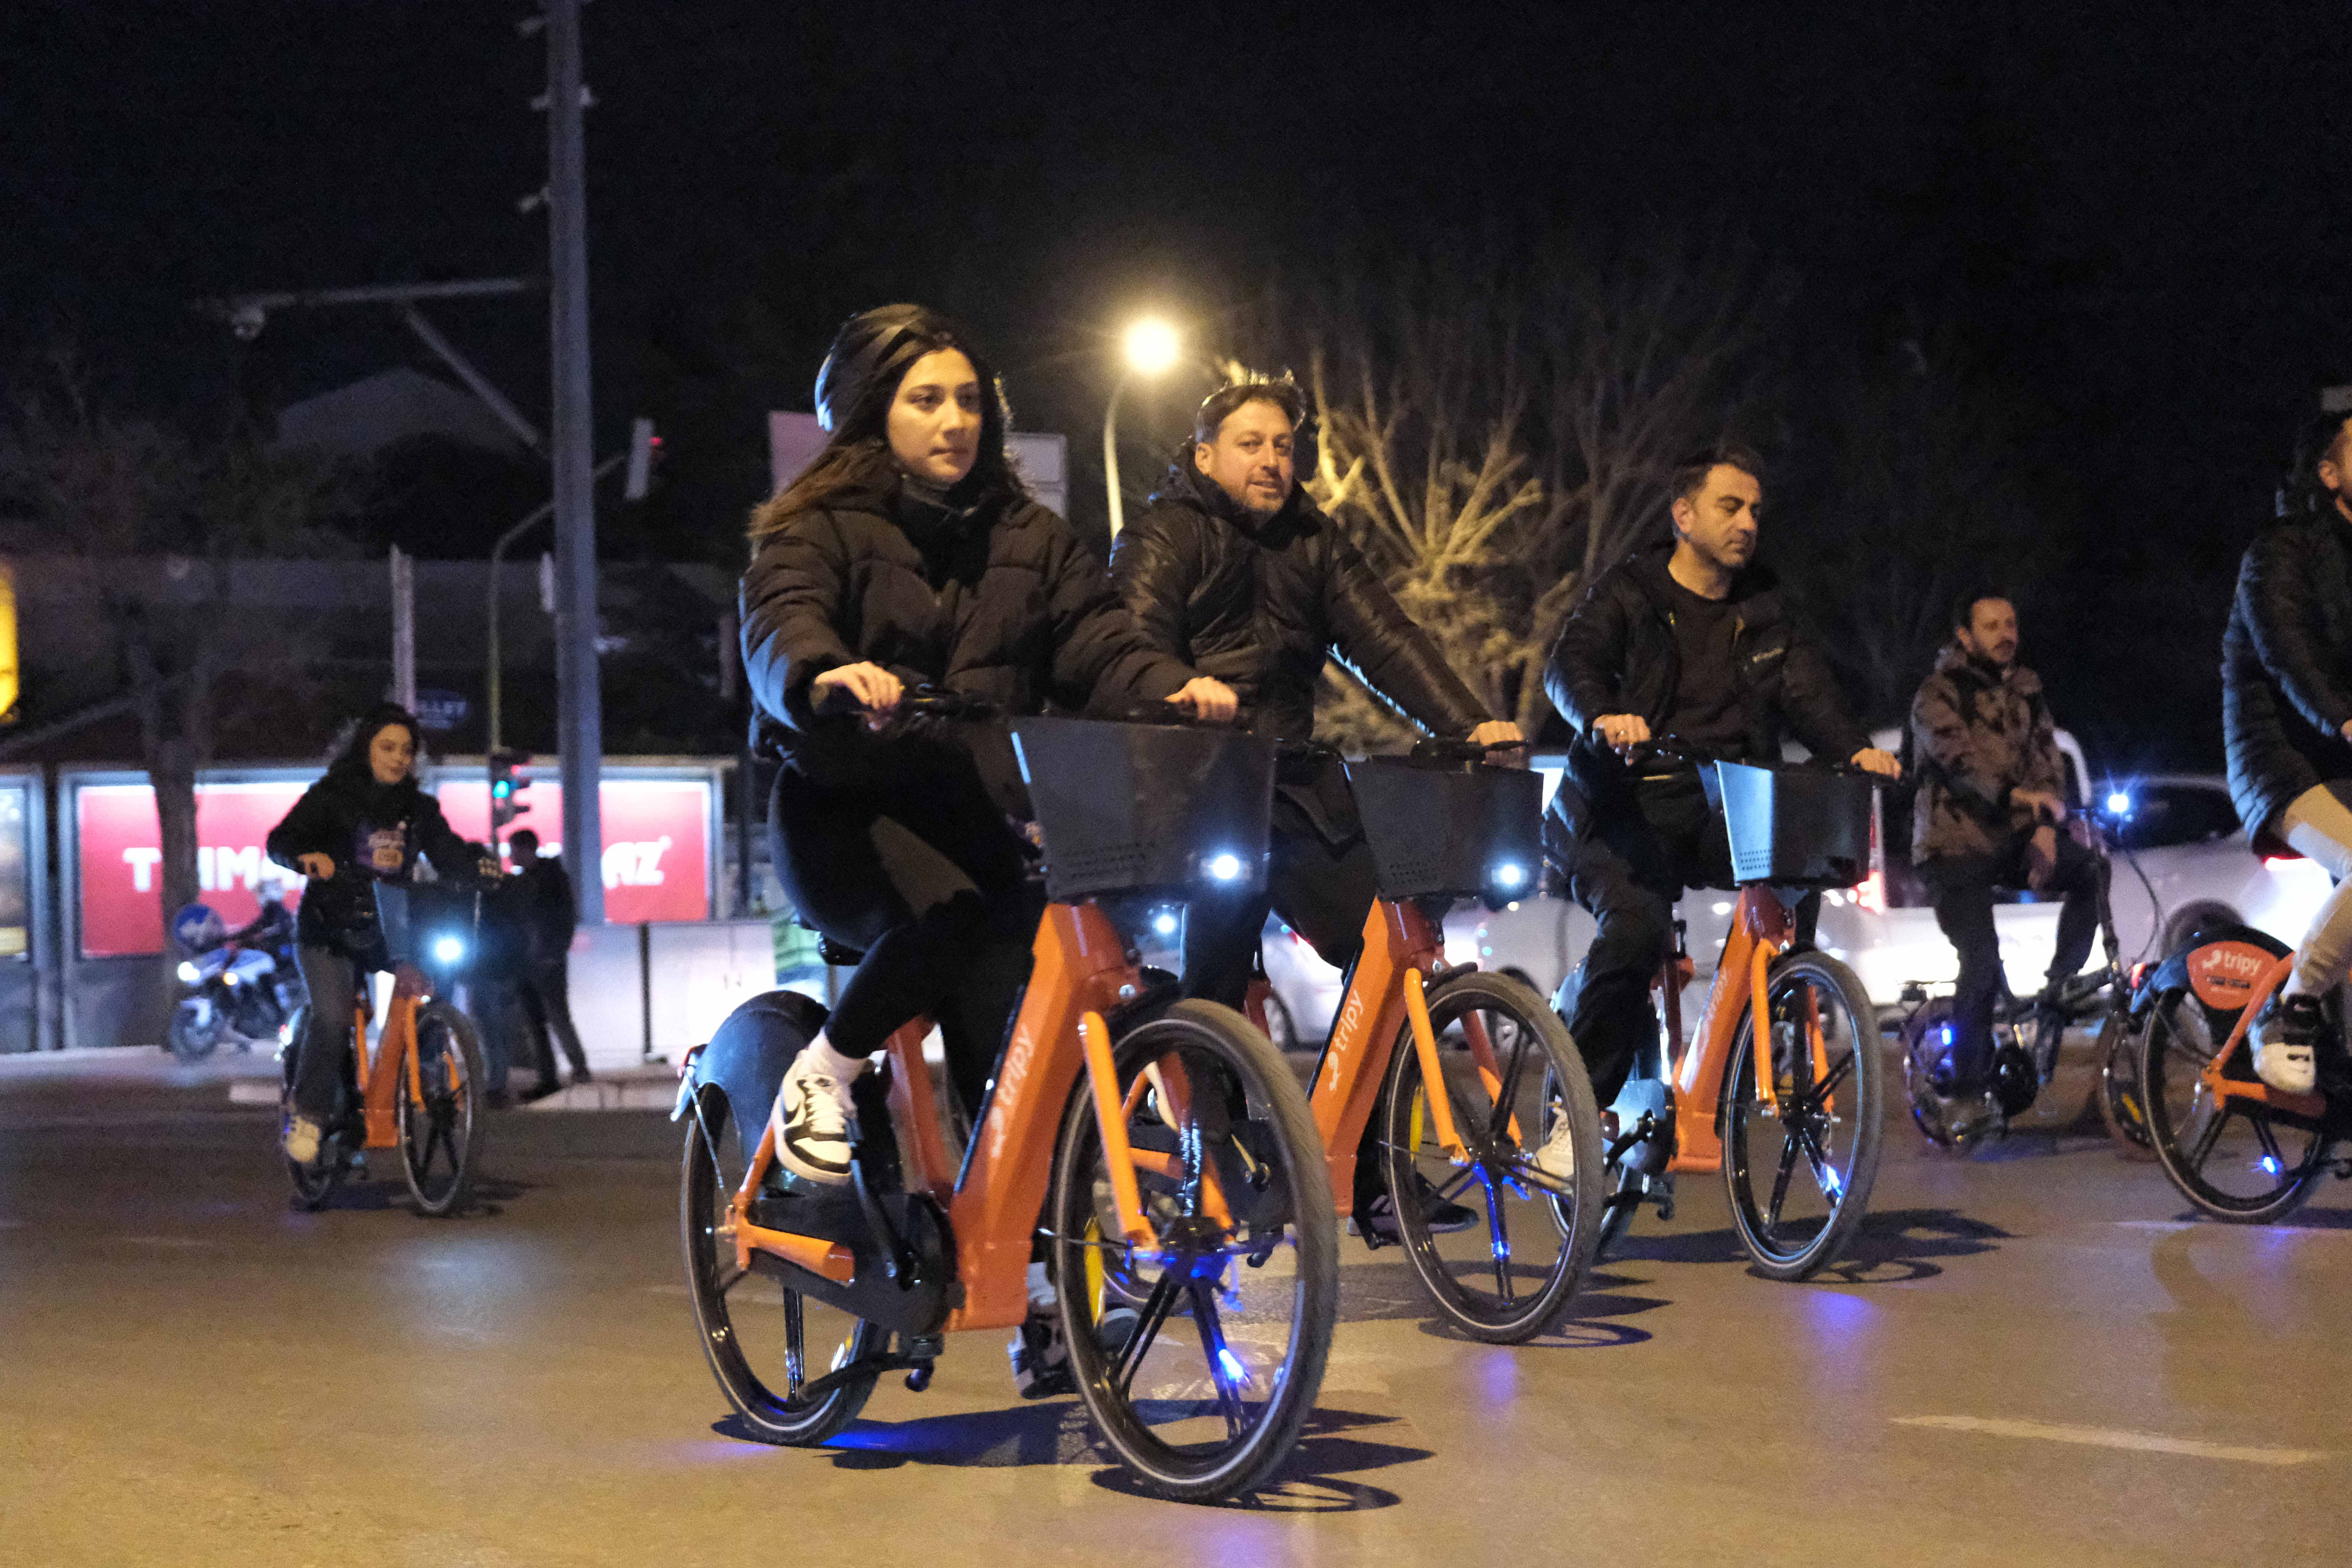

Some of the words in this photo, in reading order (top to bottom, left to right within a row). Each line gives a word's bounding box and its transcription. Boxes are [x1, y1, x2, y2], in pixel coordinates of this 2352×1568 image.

[2225, 951, 2262, 976] tripy
[1334, 989, 1363, 1052] tripy
[998, 1024, 1034, 1106] tripy
